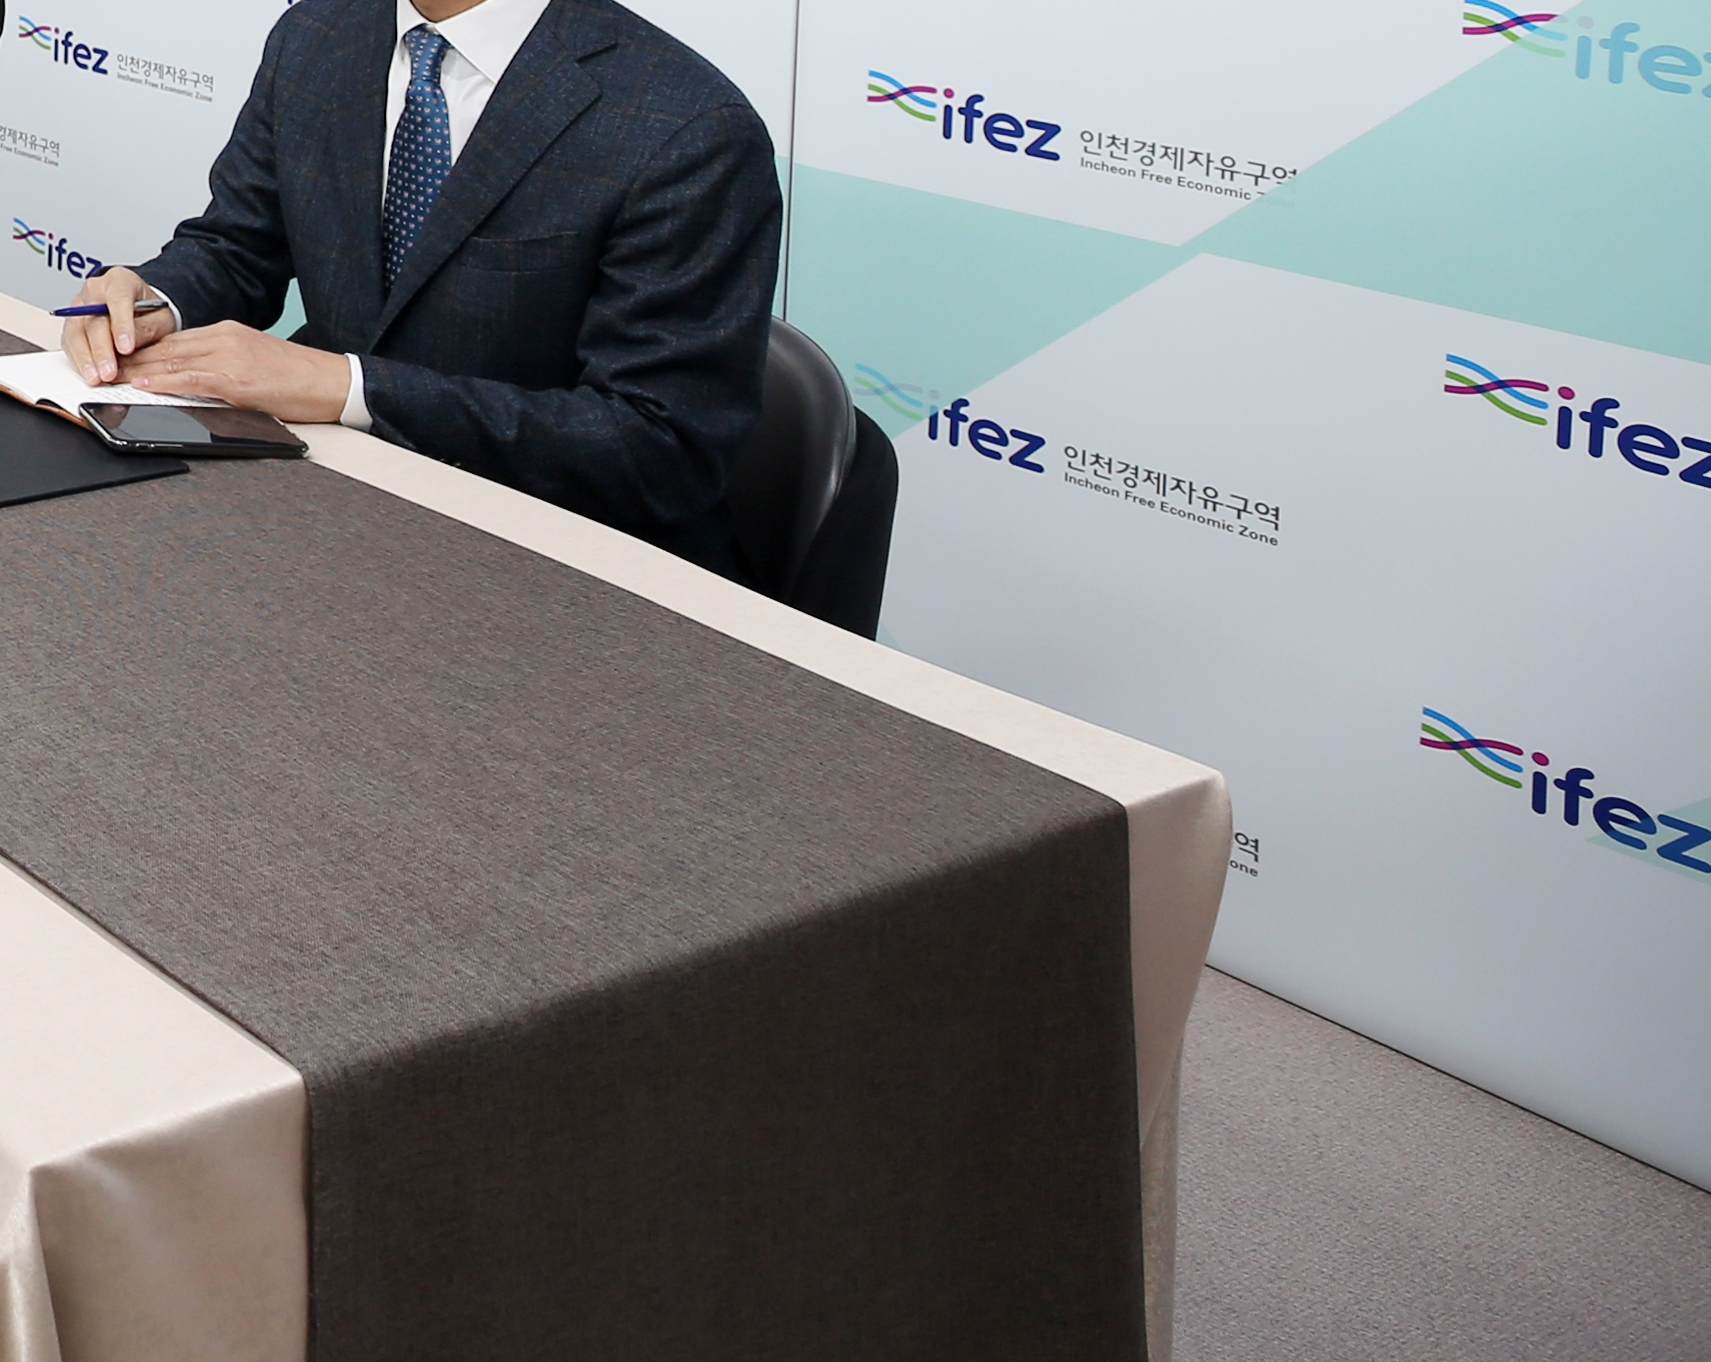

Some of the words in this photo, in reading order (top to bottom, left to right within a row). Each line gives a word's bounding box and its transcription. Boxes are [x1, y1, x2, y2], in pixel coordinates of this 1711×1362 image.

[54, 27, 109, 75] ifez
[117, 53, 214, 93] 인천경제자유구역
[942, 88, 1062, 162] ifez
[1080, 157, 1137, 178] Incheon
[1141, 169, 1173, 186] Free
[1177, 175, 1252, 201] Economic
[928, 389, 1046, 474] ifez
[1064, 445, 1281, 532] 인천경제자유구역
[1064, 472, 1120, 498] Incheon
[1124, 490, 1156, 509] Free
[1160, 501, 1235, 533] Economic
[1238, 524, 1279, 547] Zone
